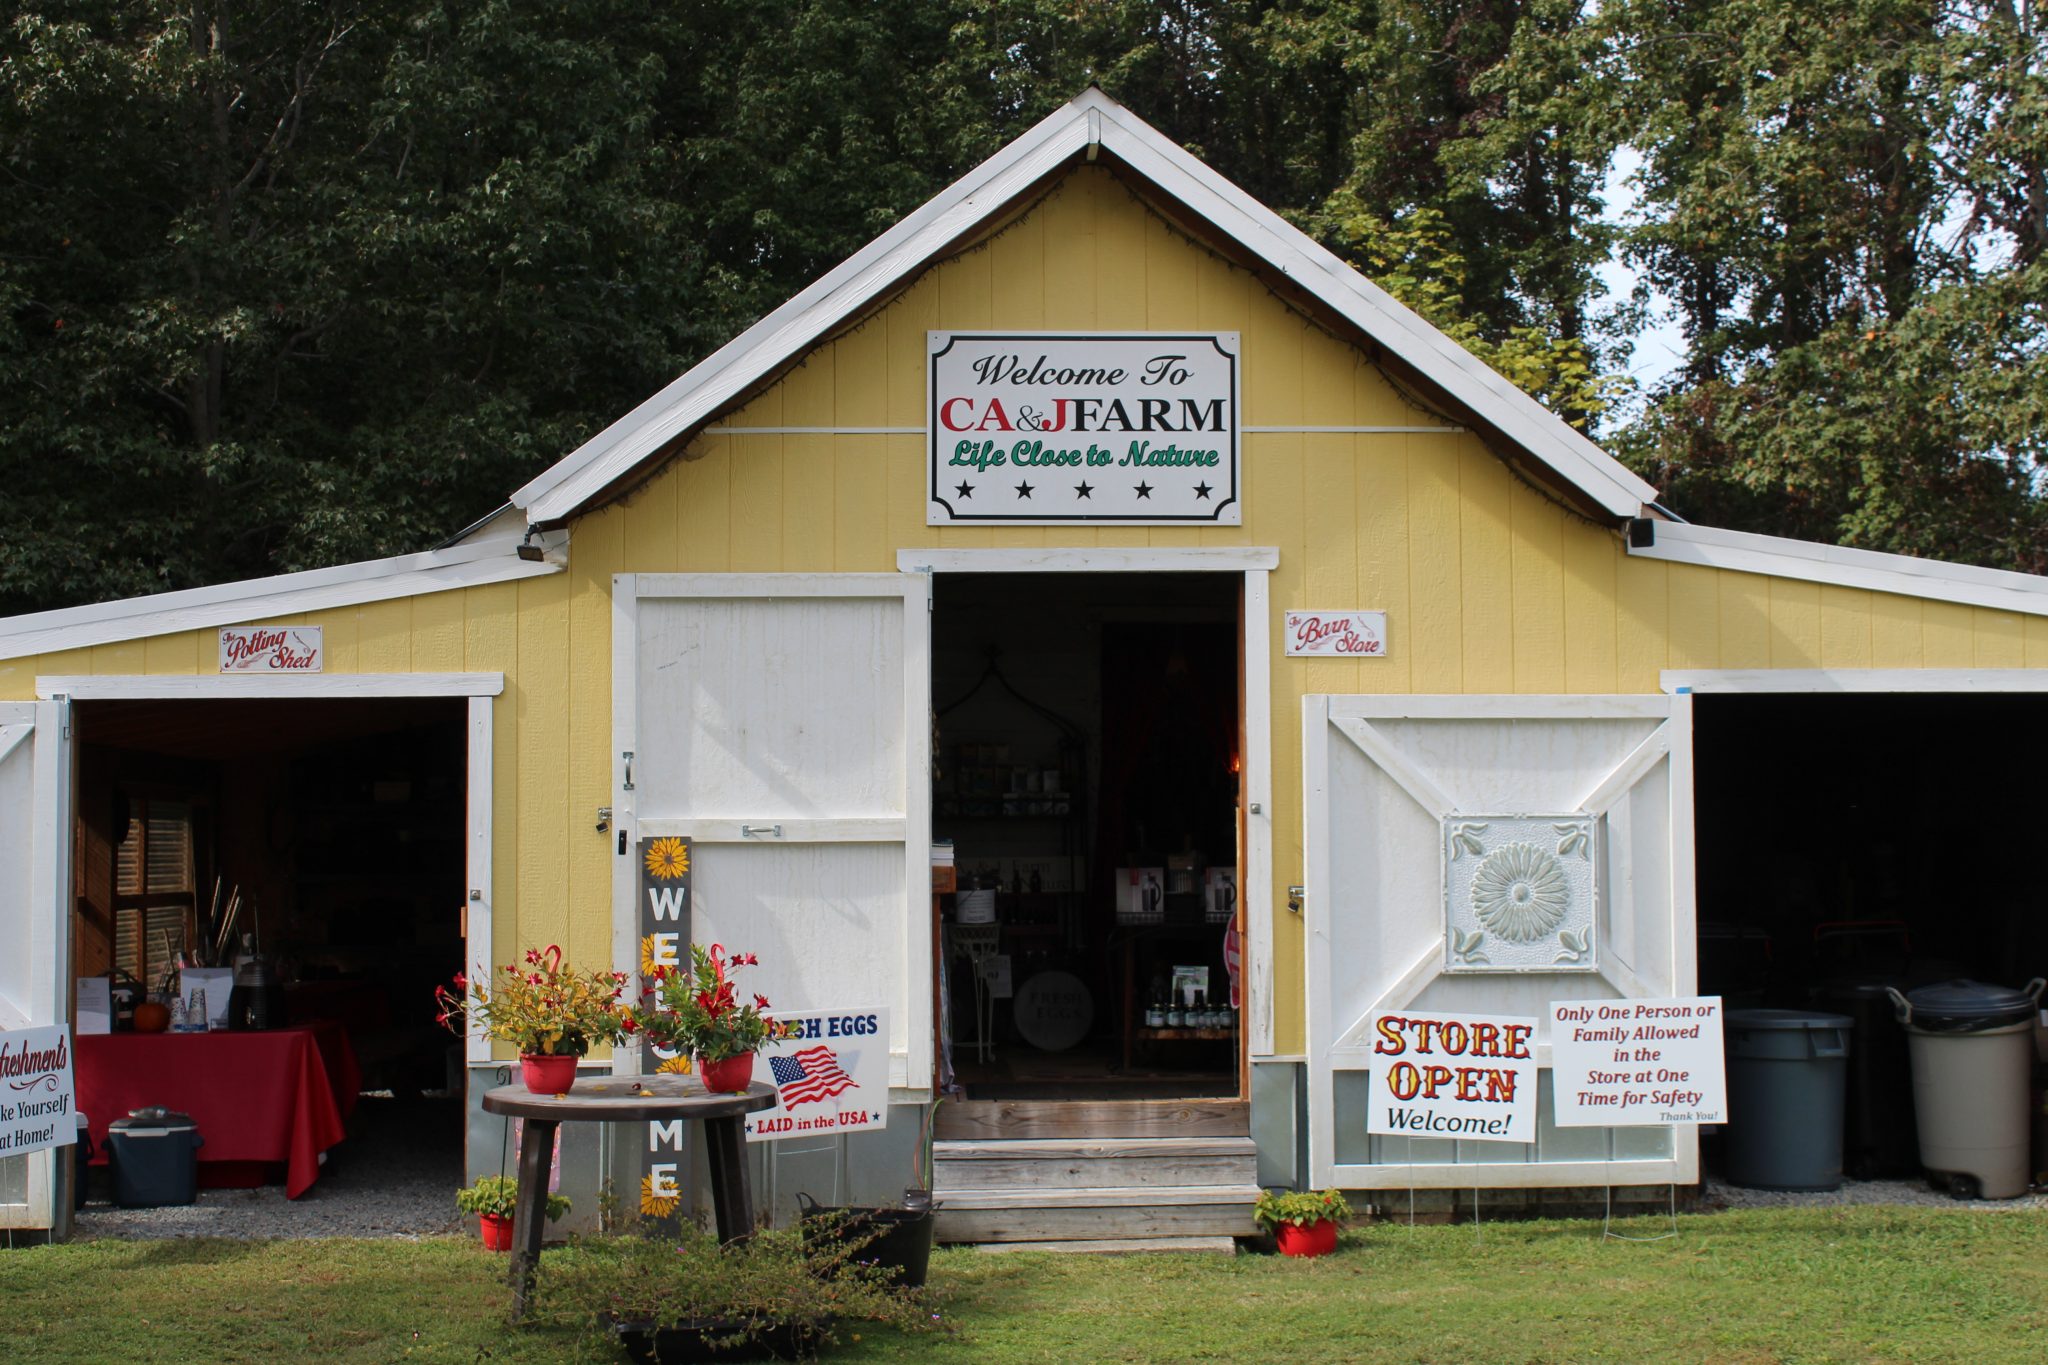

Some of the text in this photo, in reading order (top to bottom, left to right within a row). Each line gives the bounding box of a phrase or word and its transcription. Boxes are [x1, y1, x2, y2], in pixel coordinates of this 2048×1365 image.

[972, 355, 1194, 385] Welcome To
[948, 440, 1219, 472] Life Close to Nature
[1295, 617, 1352, 651] Barn
[1335, 630, 1379, 653] Store
[225, 630, 288, 669] Potting
[269, 646, 317, 669] Shed
[828, 1014, 878, 1037] EGGS
[1556, 1005, 1715, 1024] Only One Person or
[1374, 1015, 1533, 1060] STORE
[1573, 1024, 1700, 1044] Family Allowed
[0, 1034, 66, 1081] freshments
[1614, 1048, 1661, 1062] in the
[1386, 1061, 1519, 1103] OPEN
[1587, 1068, 1689, 1084] Store at One
[1, 1093, 69, 1121] ke Yourself
[1577, 1089, 1704, 1108] Time for Safety
[757, 1110, 868, 1134] LAID in the USA
[1388, 1107, 1512, 1135] Welcome!
[1659, 1111, 1718, 1121] Thank You!
[15, 1123, 54, 1147] Home!
